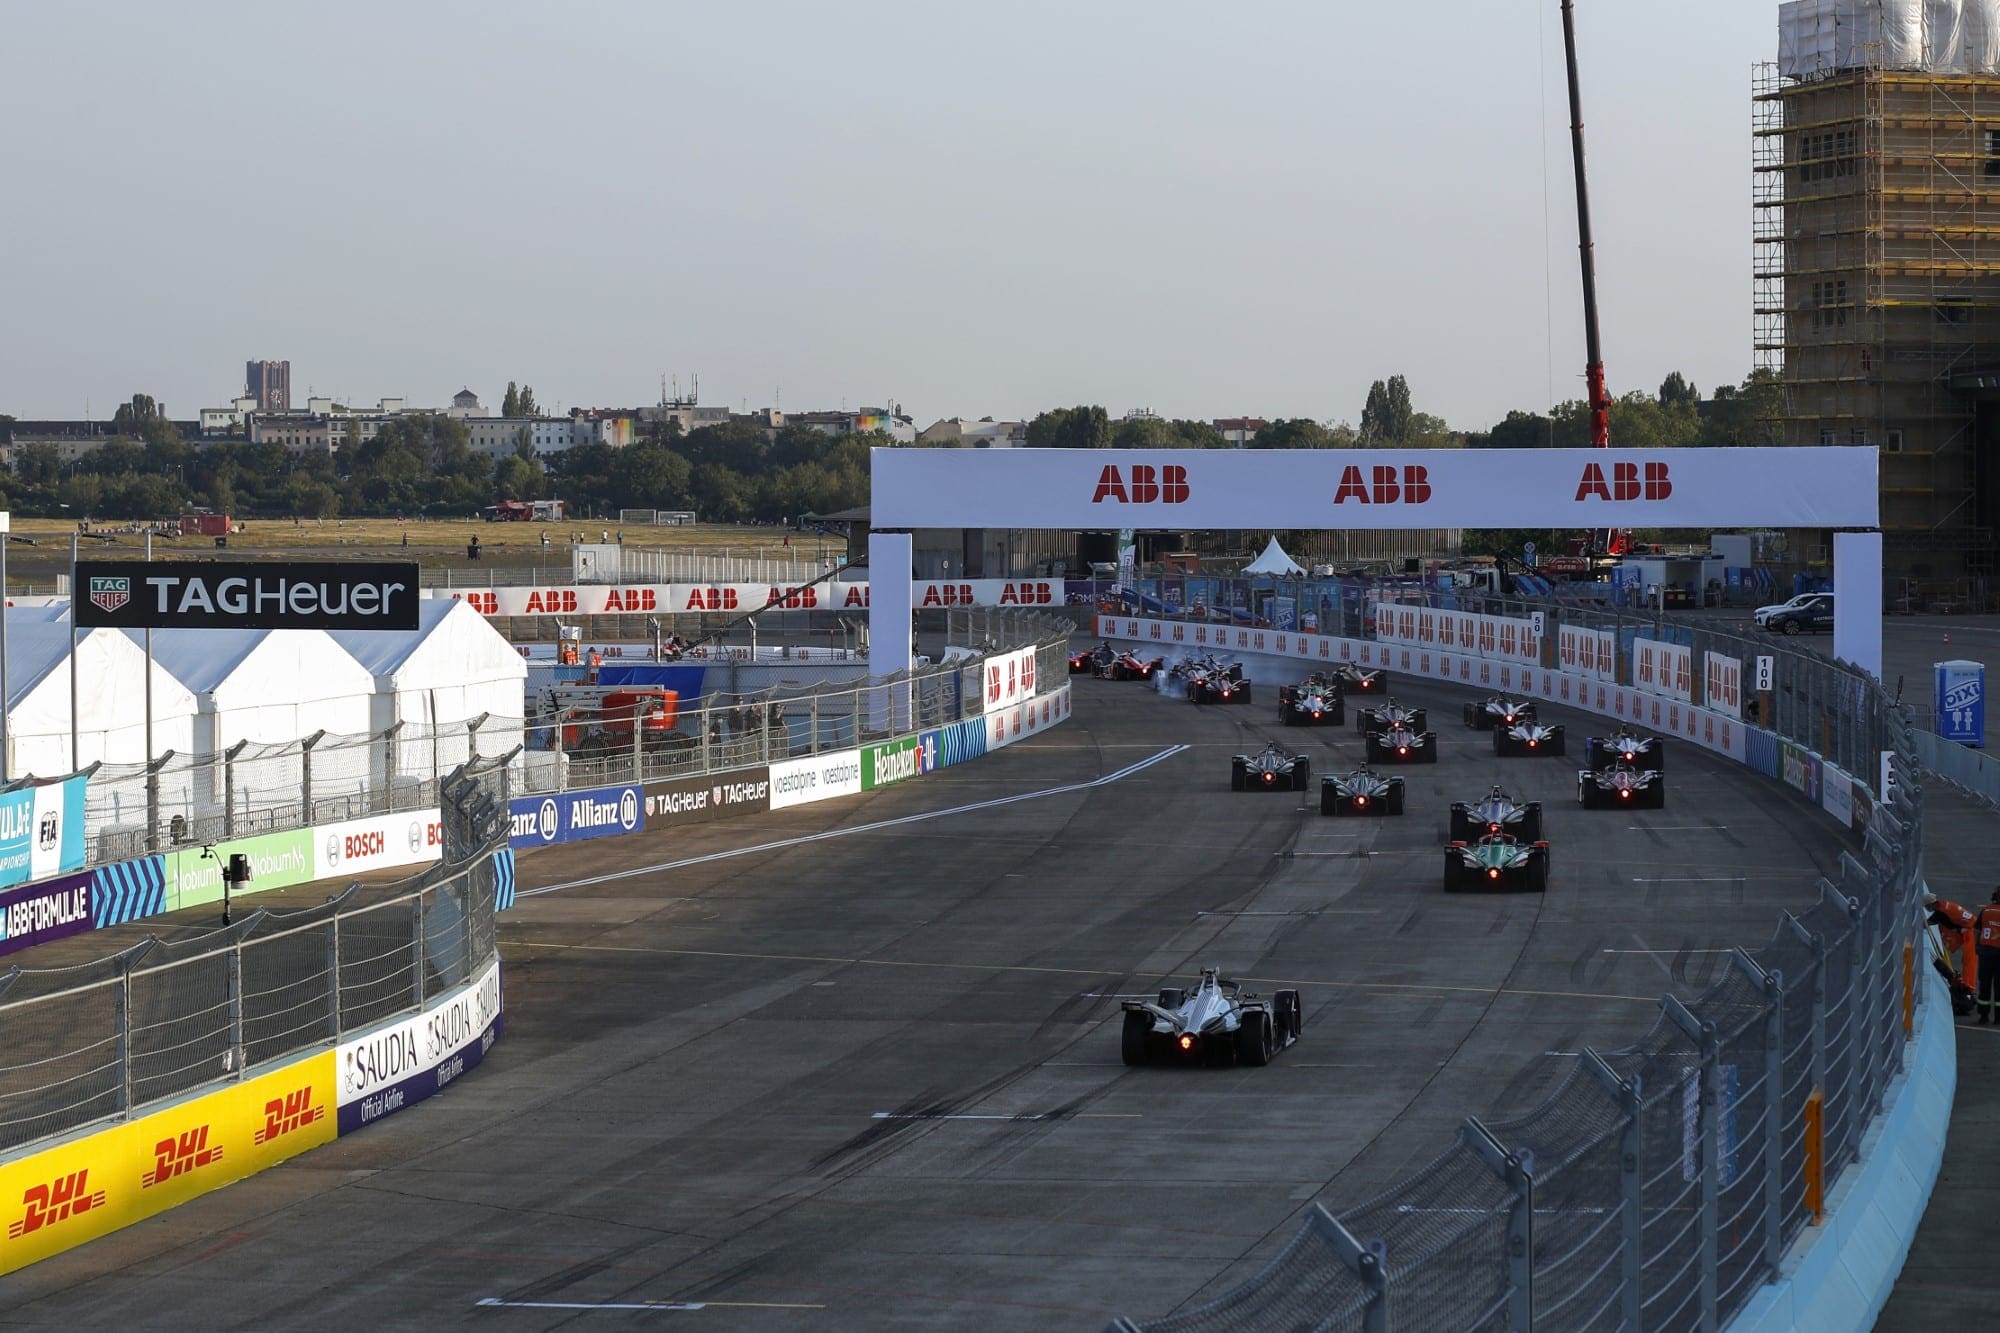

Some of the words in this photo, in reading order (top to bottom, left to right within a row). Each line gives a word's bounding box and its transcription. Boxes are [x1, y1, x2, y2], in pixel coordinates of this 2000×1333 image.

[1092, 465, 1190, 504] ABB
[1333, 465, 1431, 504] ABB
[1575, 463, 1672, 501] ABB
[93, 580, 126, 590] TAG
[146, 577, 405, 615] TAGHeuer
[686, 588, 739, 610] ABB
[766, 587, 817, 608] ABB
[923, 585, 974, 606] ABB
[1000, 583, 1052, 604] ABB
[93, 593, 128, 608] HEUER
[526, 590, 578, 613] ABB
[604, 589, 656, 611] ABB
[1534, 617, 1541, 632] 50
[516, 647, 530, 657] BB
[1945, 682, 1980, 707] DIXI
[822, 759, 858, 788] voestalpine
[874, 742, 915, 785] Heineken
[723, 781, 768, 804] TAGHeuer
[773, 764, 816, 795] voestalpine
[571, 799, 618, 829] Allianz
[657, 791, 709, 815] TAGHeuer
[507, 809, 537, 837] ianz
[345, 831, 384, 859] BOSCH
[434, 998, 471, 1056] SAUDIA
[356, 1027, 418, 1090] SAUDIA
[264, 1086, 317, 1141] DHL
[361, 1093, 383, 1122] Official
[384, 1088, 403, 1113] Airline
[154, 1125, 212, 1184] DHL
[22, 1169, 94, 1235] DHL
